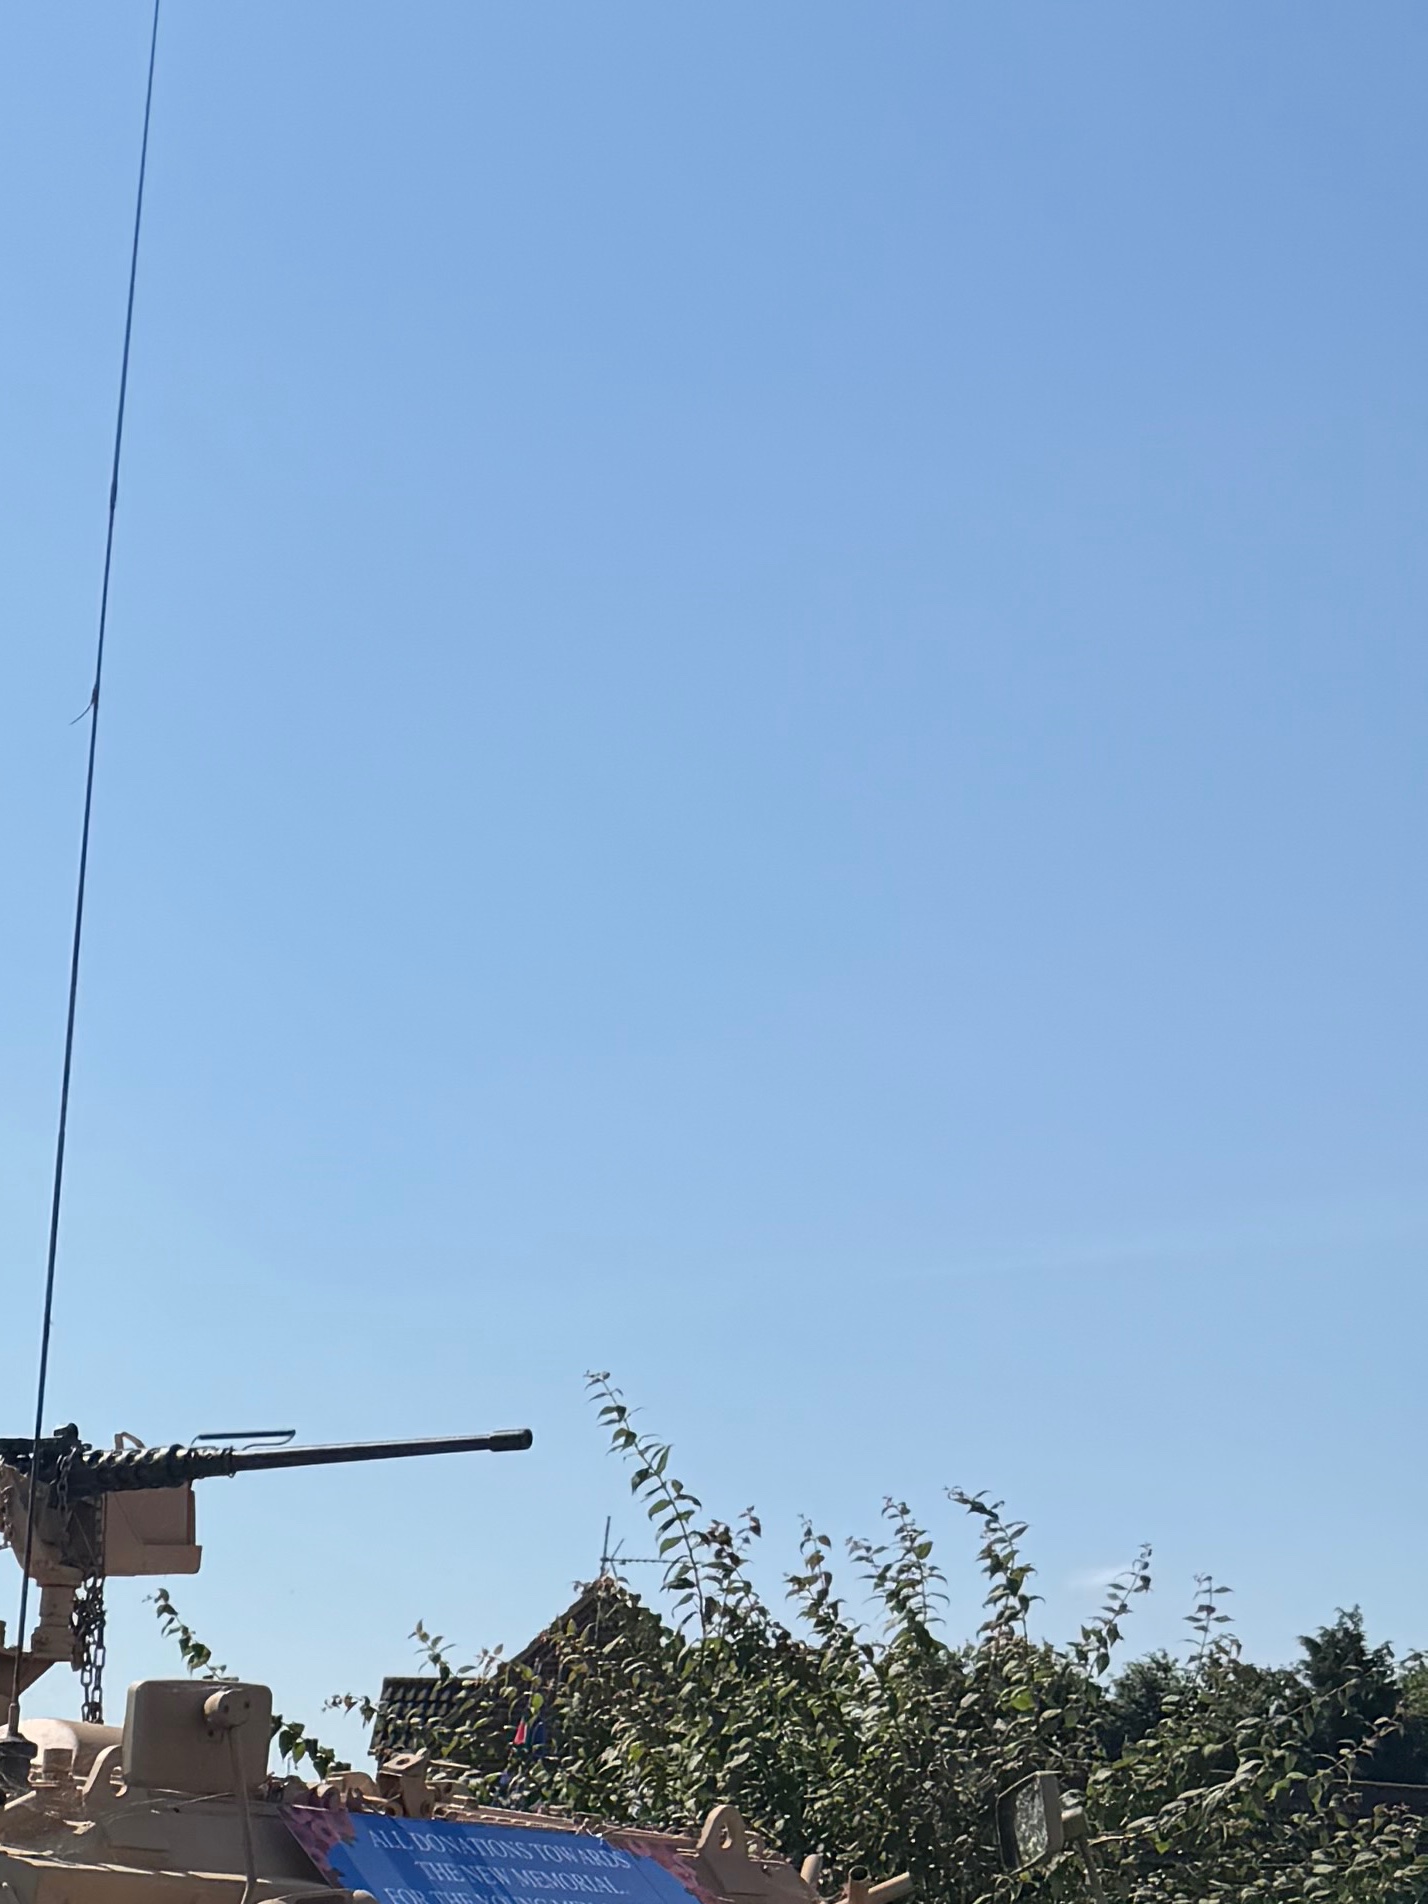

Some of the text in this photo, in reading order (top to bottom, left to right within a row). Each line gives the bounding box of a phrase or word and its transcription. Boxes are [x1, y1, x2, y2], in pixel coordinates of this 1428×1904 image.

[369, 1829, 632, 1869] ALL DONATIONS TOWARDS
[415, 1861, 465, 1882] THE
[460, 1864, 511, 1886] NEW
